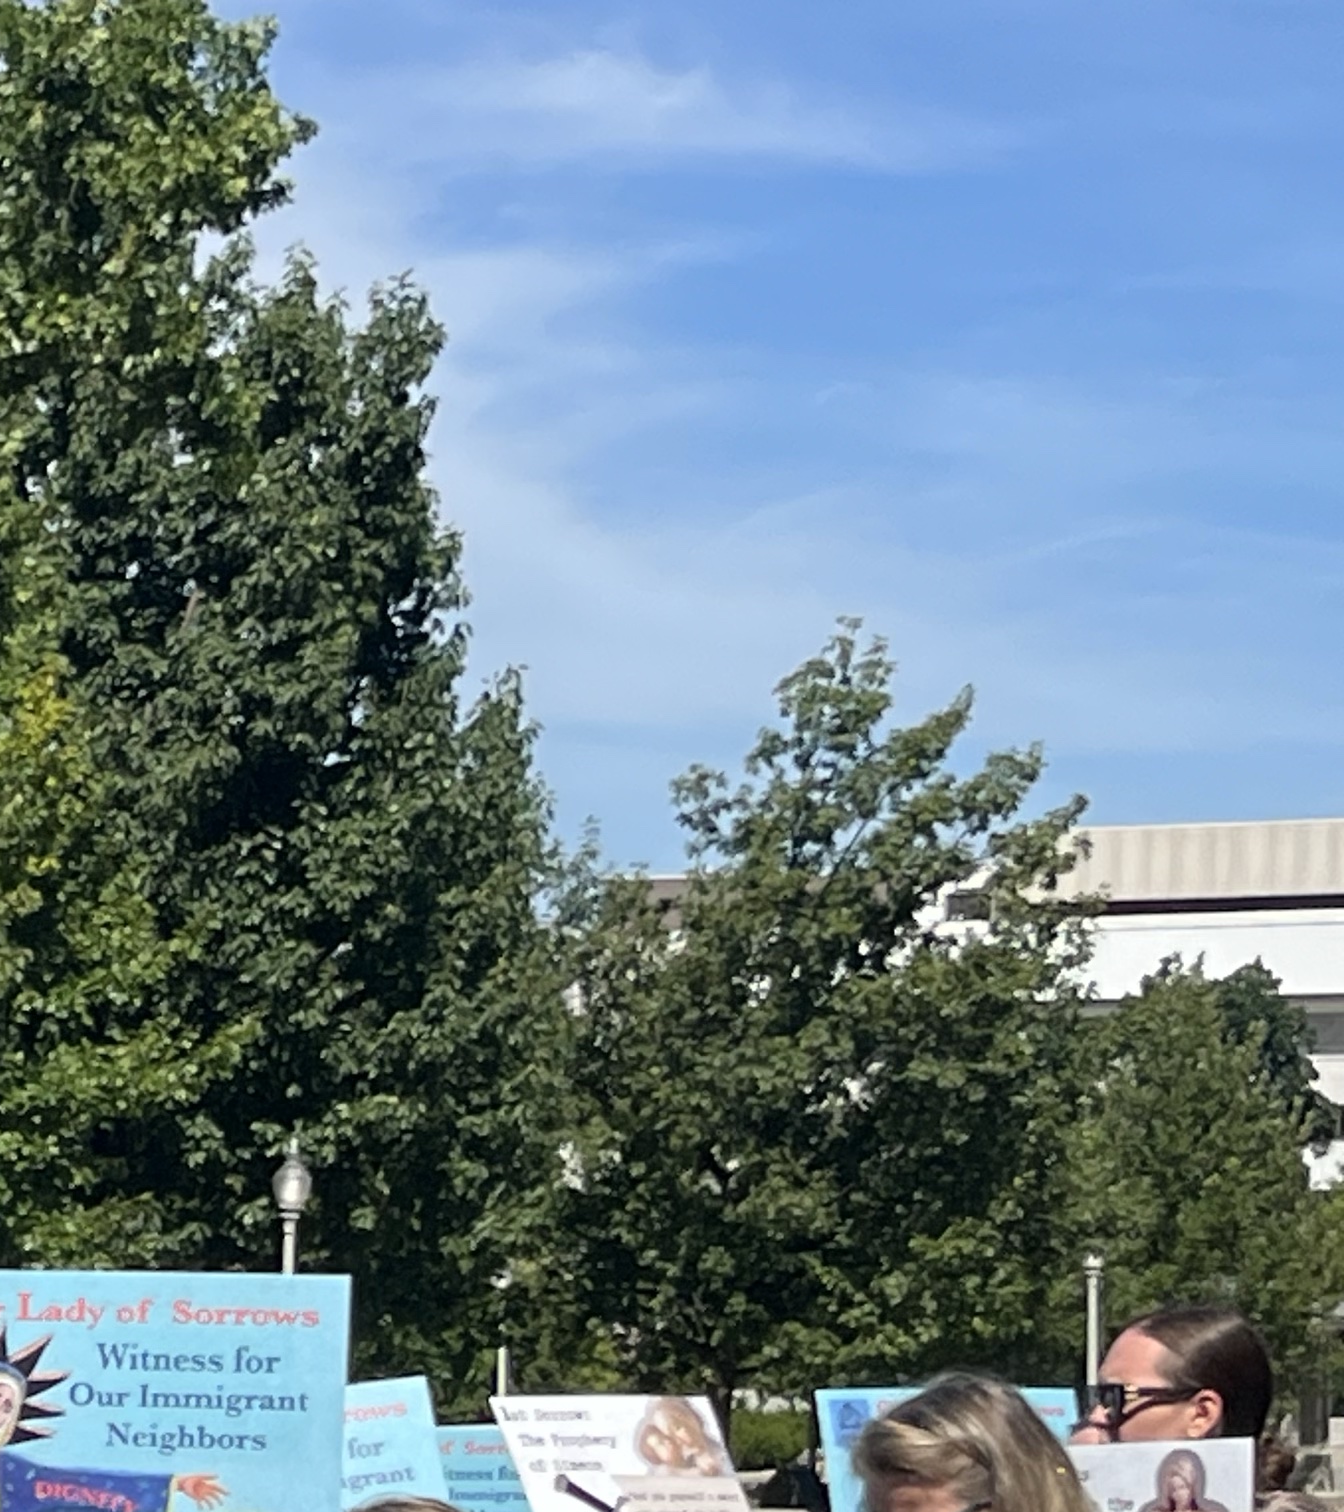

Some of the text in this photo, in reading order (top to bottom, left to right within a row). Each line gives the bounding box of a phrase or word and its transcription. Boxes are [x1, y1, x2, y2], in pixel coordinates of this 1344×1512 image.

[16, 1292, 105, 1330] Lady
[116, 1298, 154, 1324] of
[172, 1300, 320, 1328] Sorrows
[97, 1343, 281, 1375] Witness for
[69, 1382, 309, 1417] Our Immigrant
[345, 1403, 408, 1424] rows
[105, 1422, 267, 1456] Neighbors
[348, 1436, 385, 1460] for
